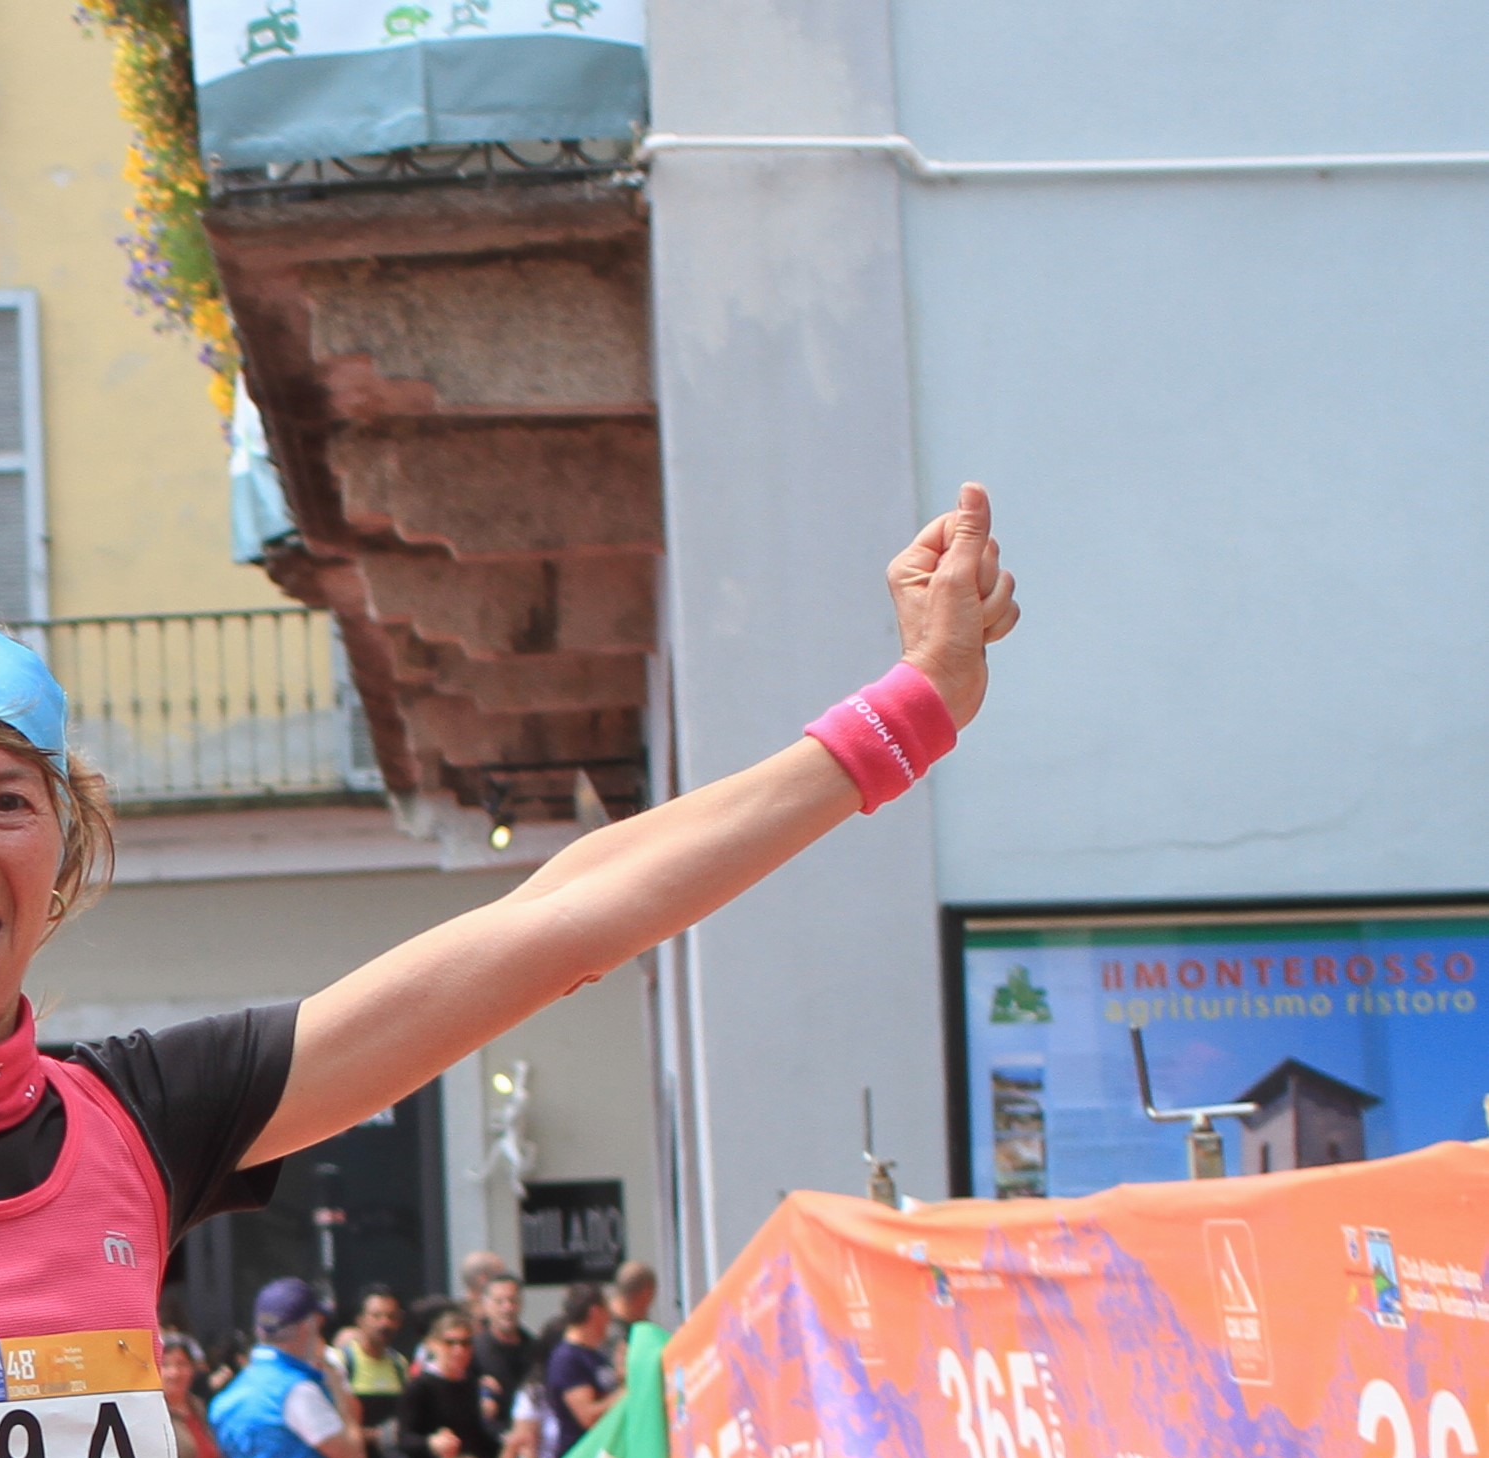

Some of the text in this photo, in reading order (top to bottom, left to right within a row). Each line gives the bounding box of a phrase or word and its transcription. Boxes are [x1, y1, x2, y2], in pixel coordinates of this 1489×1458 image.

[1134, 952, 1476, 989] MONTEROSSO
[1104, 987, 1476, 1027] agriturismo ristoro
